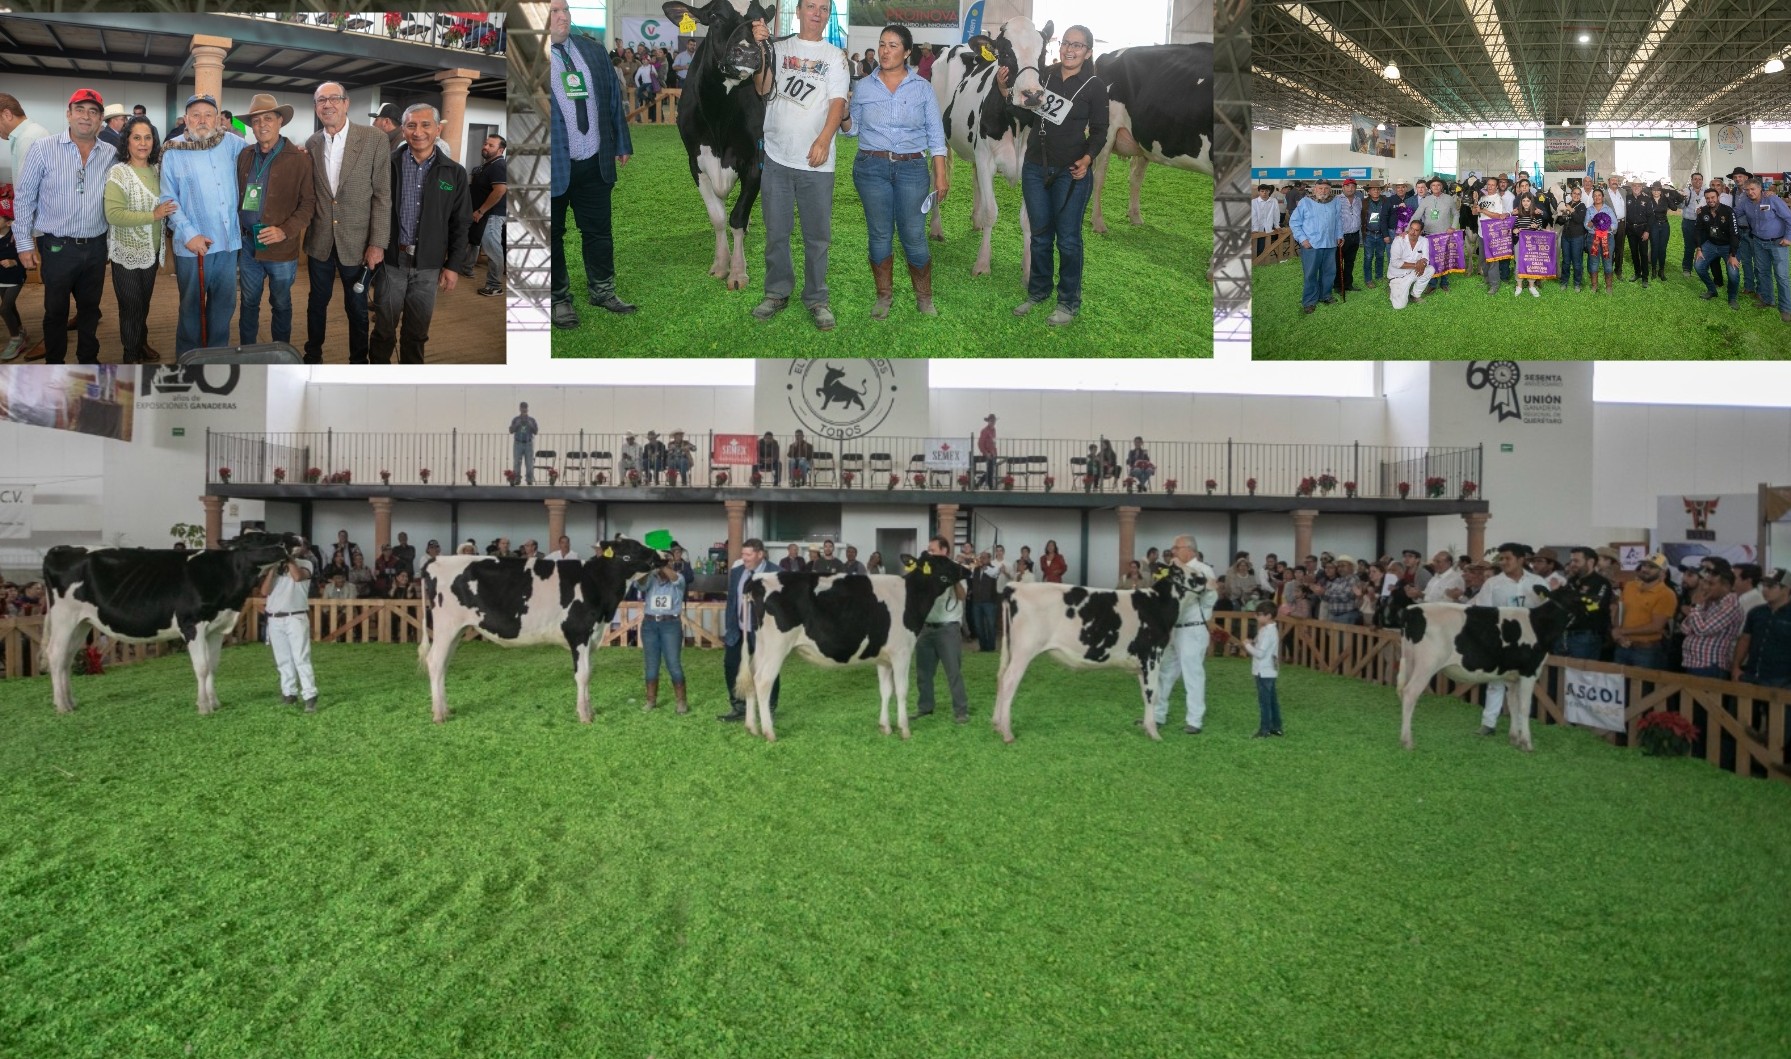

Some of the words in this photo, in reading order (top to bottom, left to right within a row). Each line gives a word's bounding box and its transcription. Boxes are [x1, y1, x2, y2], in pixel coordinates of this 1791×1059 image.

[783, 75, 816, 101] 107
[1041, 94, 1064, 118] 82
[1523, 374, 1562, 383] SESENTA
[1523, 392, 1562, 404] UNIÓN
[136, 402, 188, 410] EXPOSICIONES
[190, 402, 237, 410] GANADERAS
[820, 424, 861, 438] TODOS
[932, 450, 960, 461] SEMEX
[0, 490, 23, 503] C.V.
[655, 596, 668, 608] 62
[1565, 682, 1623, 705] ASCOL
